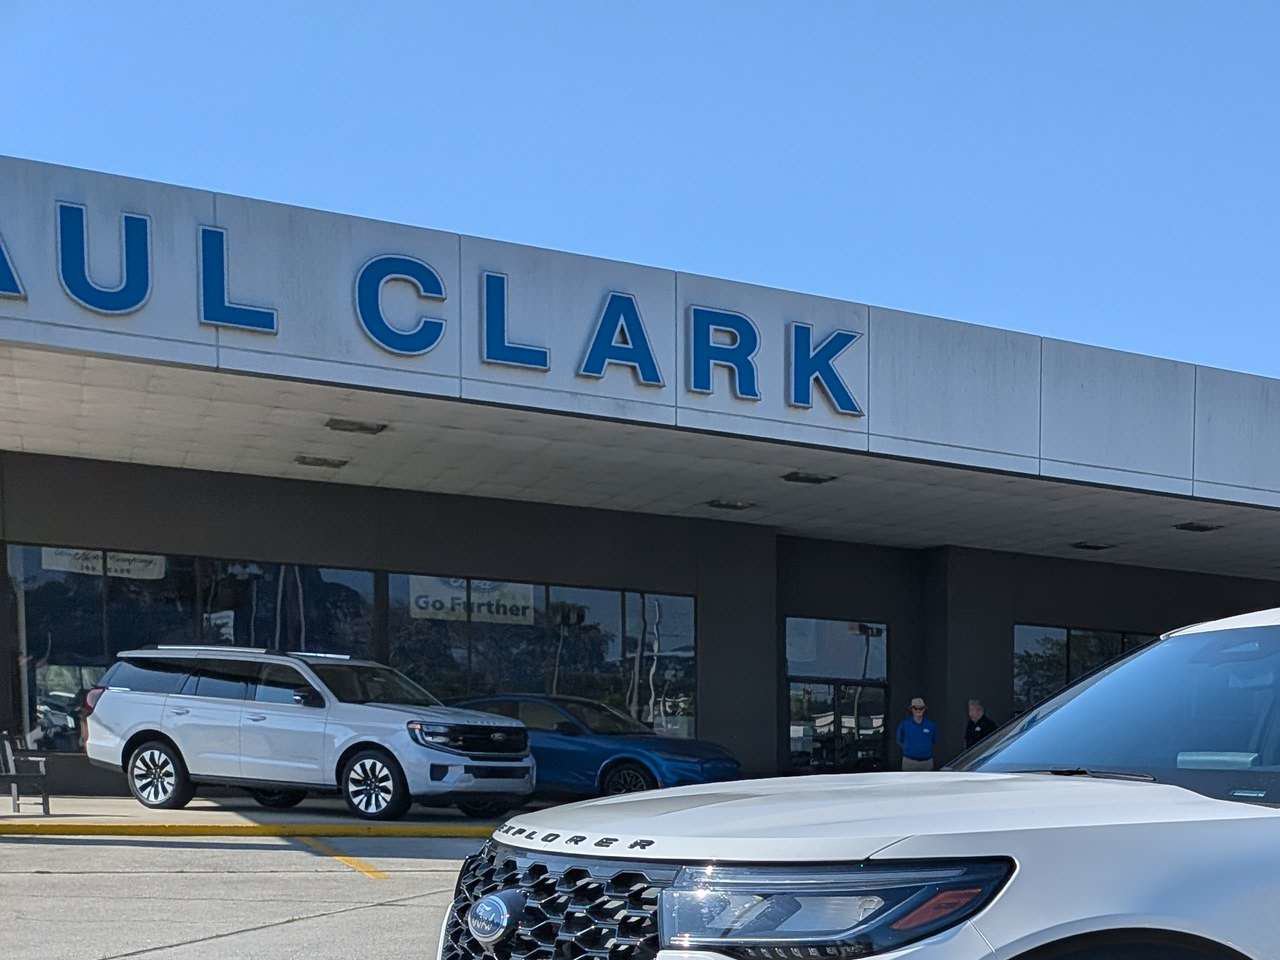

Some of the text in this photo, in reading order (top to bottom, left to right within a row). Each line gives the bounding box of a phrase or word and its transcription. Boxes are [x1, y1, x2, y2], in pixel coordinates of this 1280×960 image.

[354, 253, 864, 416] CLARK
[415, 595, 445, 611] Go
[499, 824, 656, 849] EXPLORER
